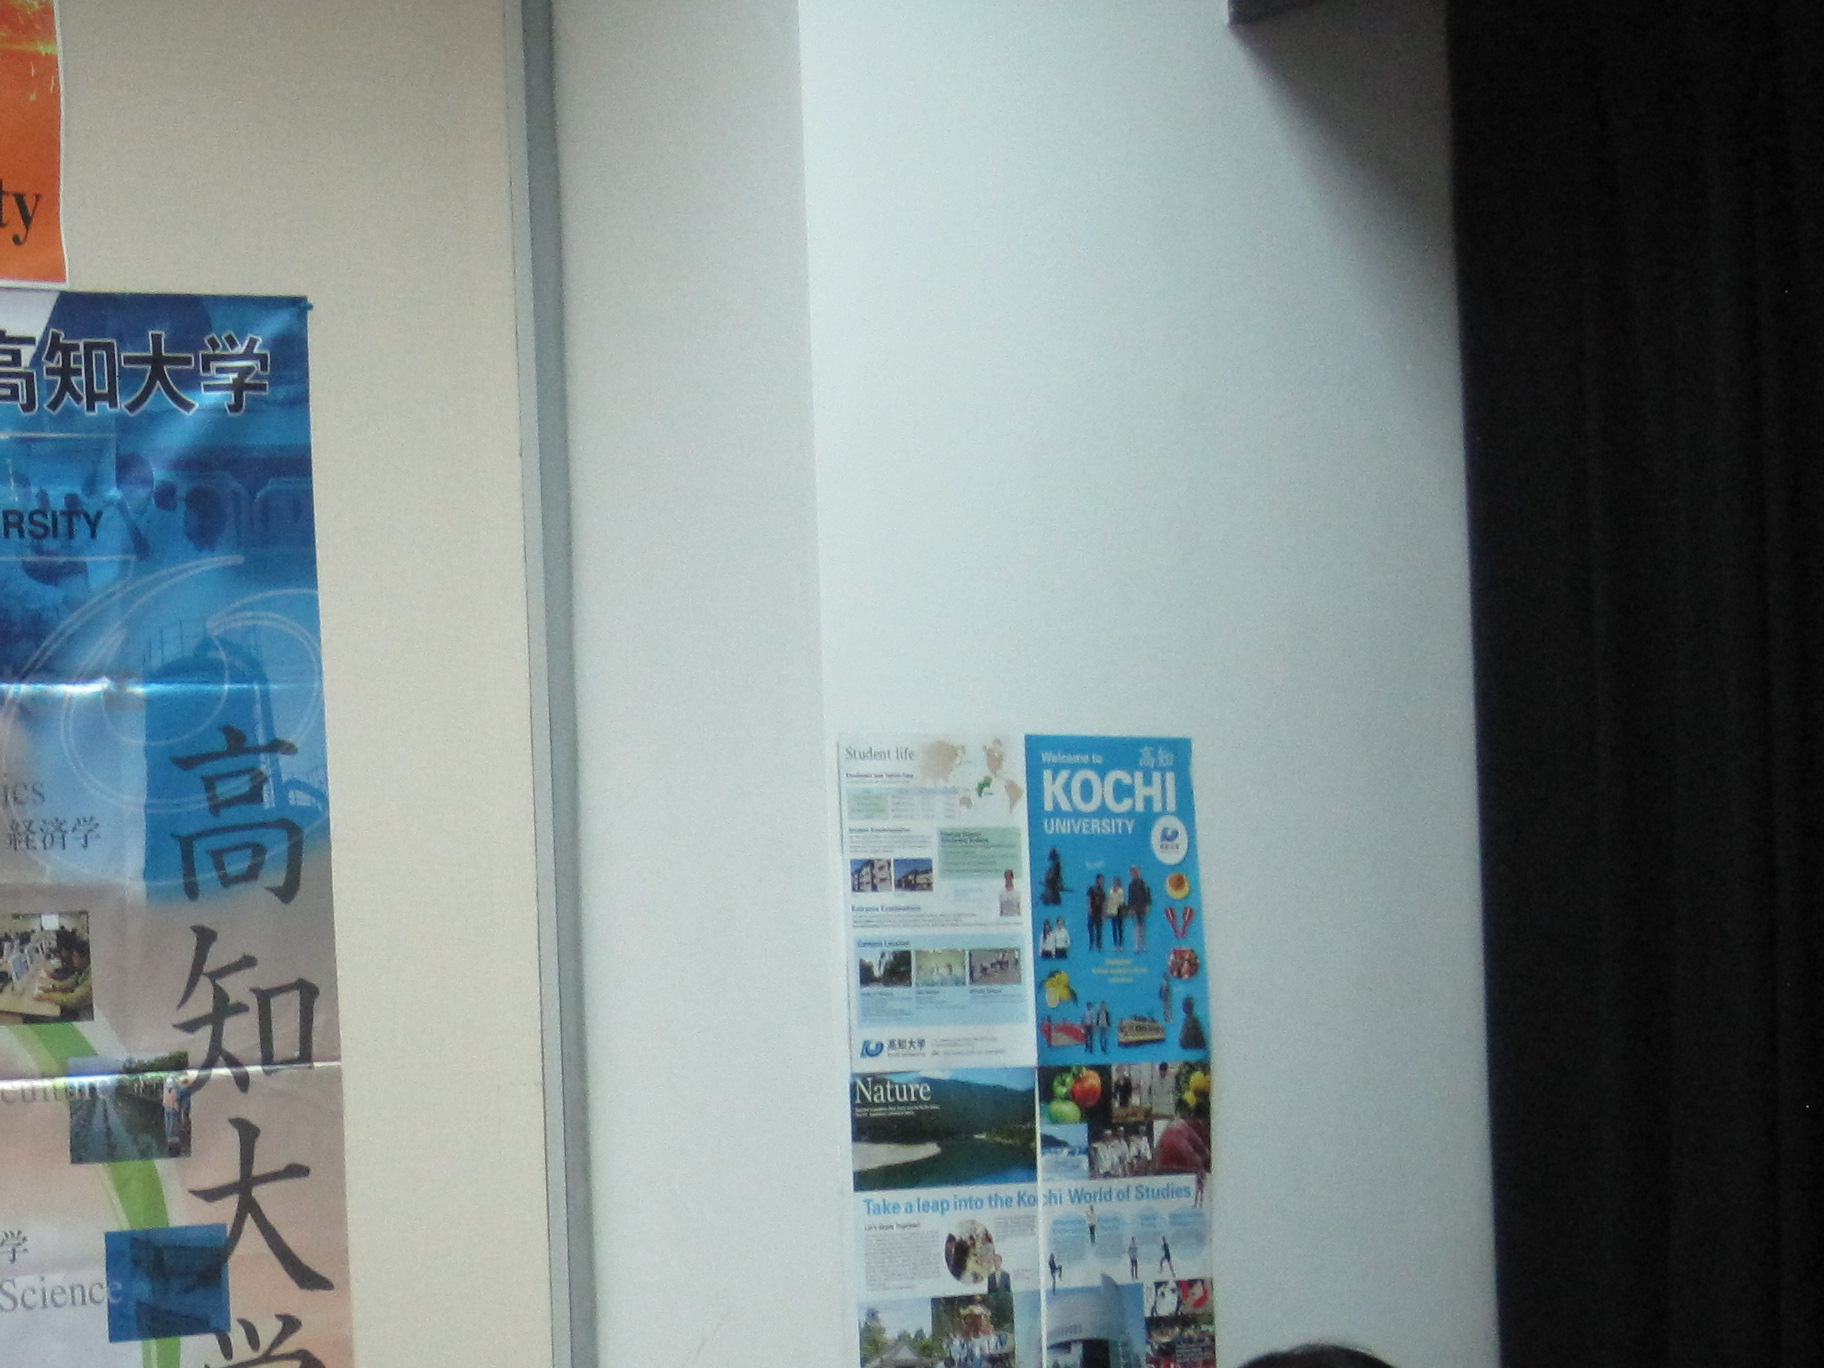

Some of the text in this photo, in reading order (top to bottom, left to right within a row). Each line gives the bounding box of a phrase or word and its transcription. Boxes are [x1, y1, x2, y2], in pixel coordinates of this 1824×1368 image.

[845, 746, 916, 761] Student life
[1042, 769, 1175, 813] KOCHI
[7, 815, 101, 853] 経済学
[1044, 818, 1134, 834] UNIVERSITY
[855, 1076, 931, 1104] Nature
[864, 1198, 901, 1215] Take
[904, 1202, 913, 1213] a
[917, 1197, 950, 1215] leap
[954, 1194, 984, 1210] into
[988, 1192, 1012, 1209] the
[1068, 1186, 1112, 1203] World
[1116, 1185, 1131, 1200] of
[1135, 1184, 1192, 1200] Studies
